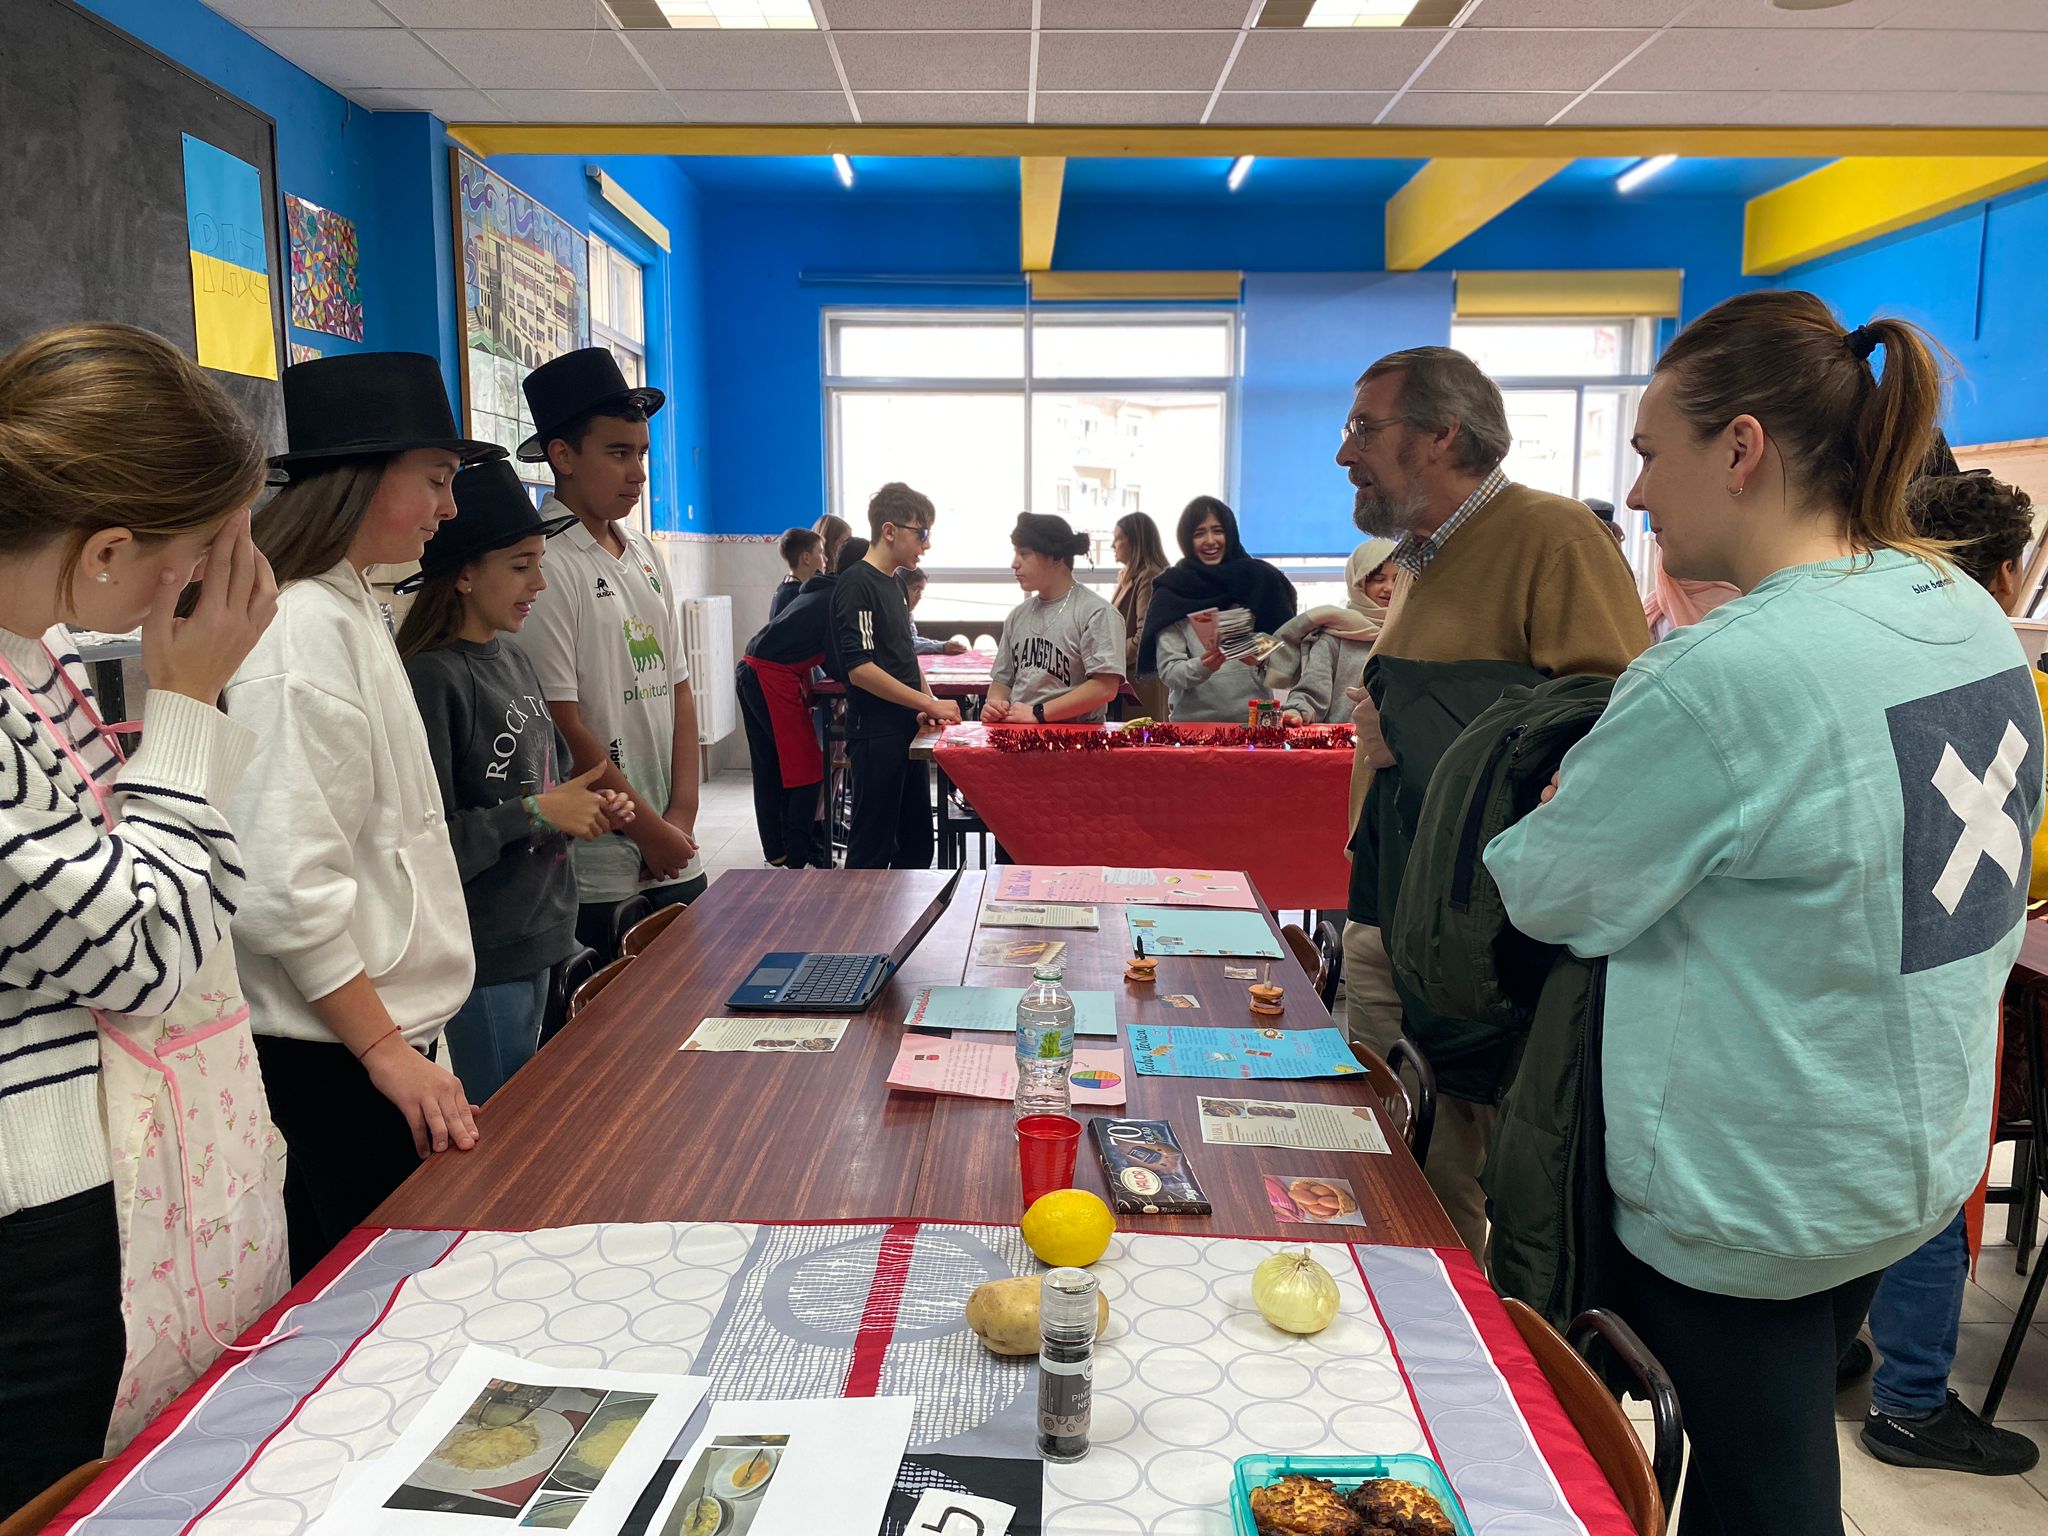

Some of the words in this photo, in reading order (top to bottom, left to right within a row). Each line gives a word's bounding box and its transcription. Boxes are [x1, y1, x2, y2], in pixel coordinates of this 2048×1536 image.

[1911, 583, 1931, 594] blue
[1020, 637, 1071, 687] ANGELES
[624, 681, 668, 704] plenitud
[485, 700, 529, 782] ROCK
[1132, 1170, 1151, 1192] VALOR
